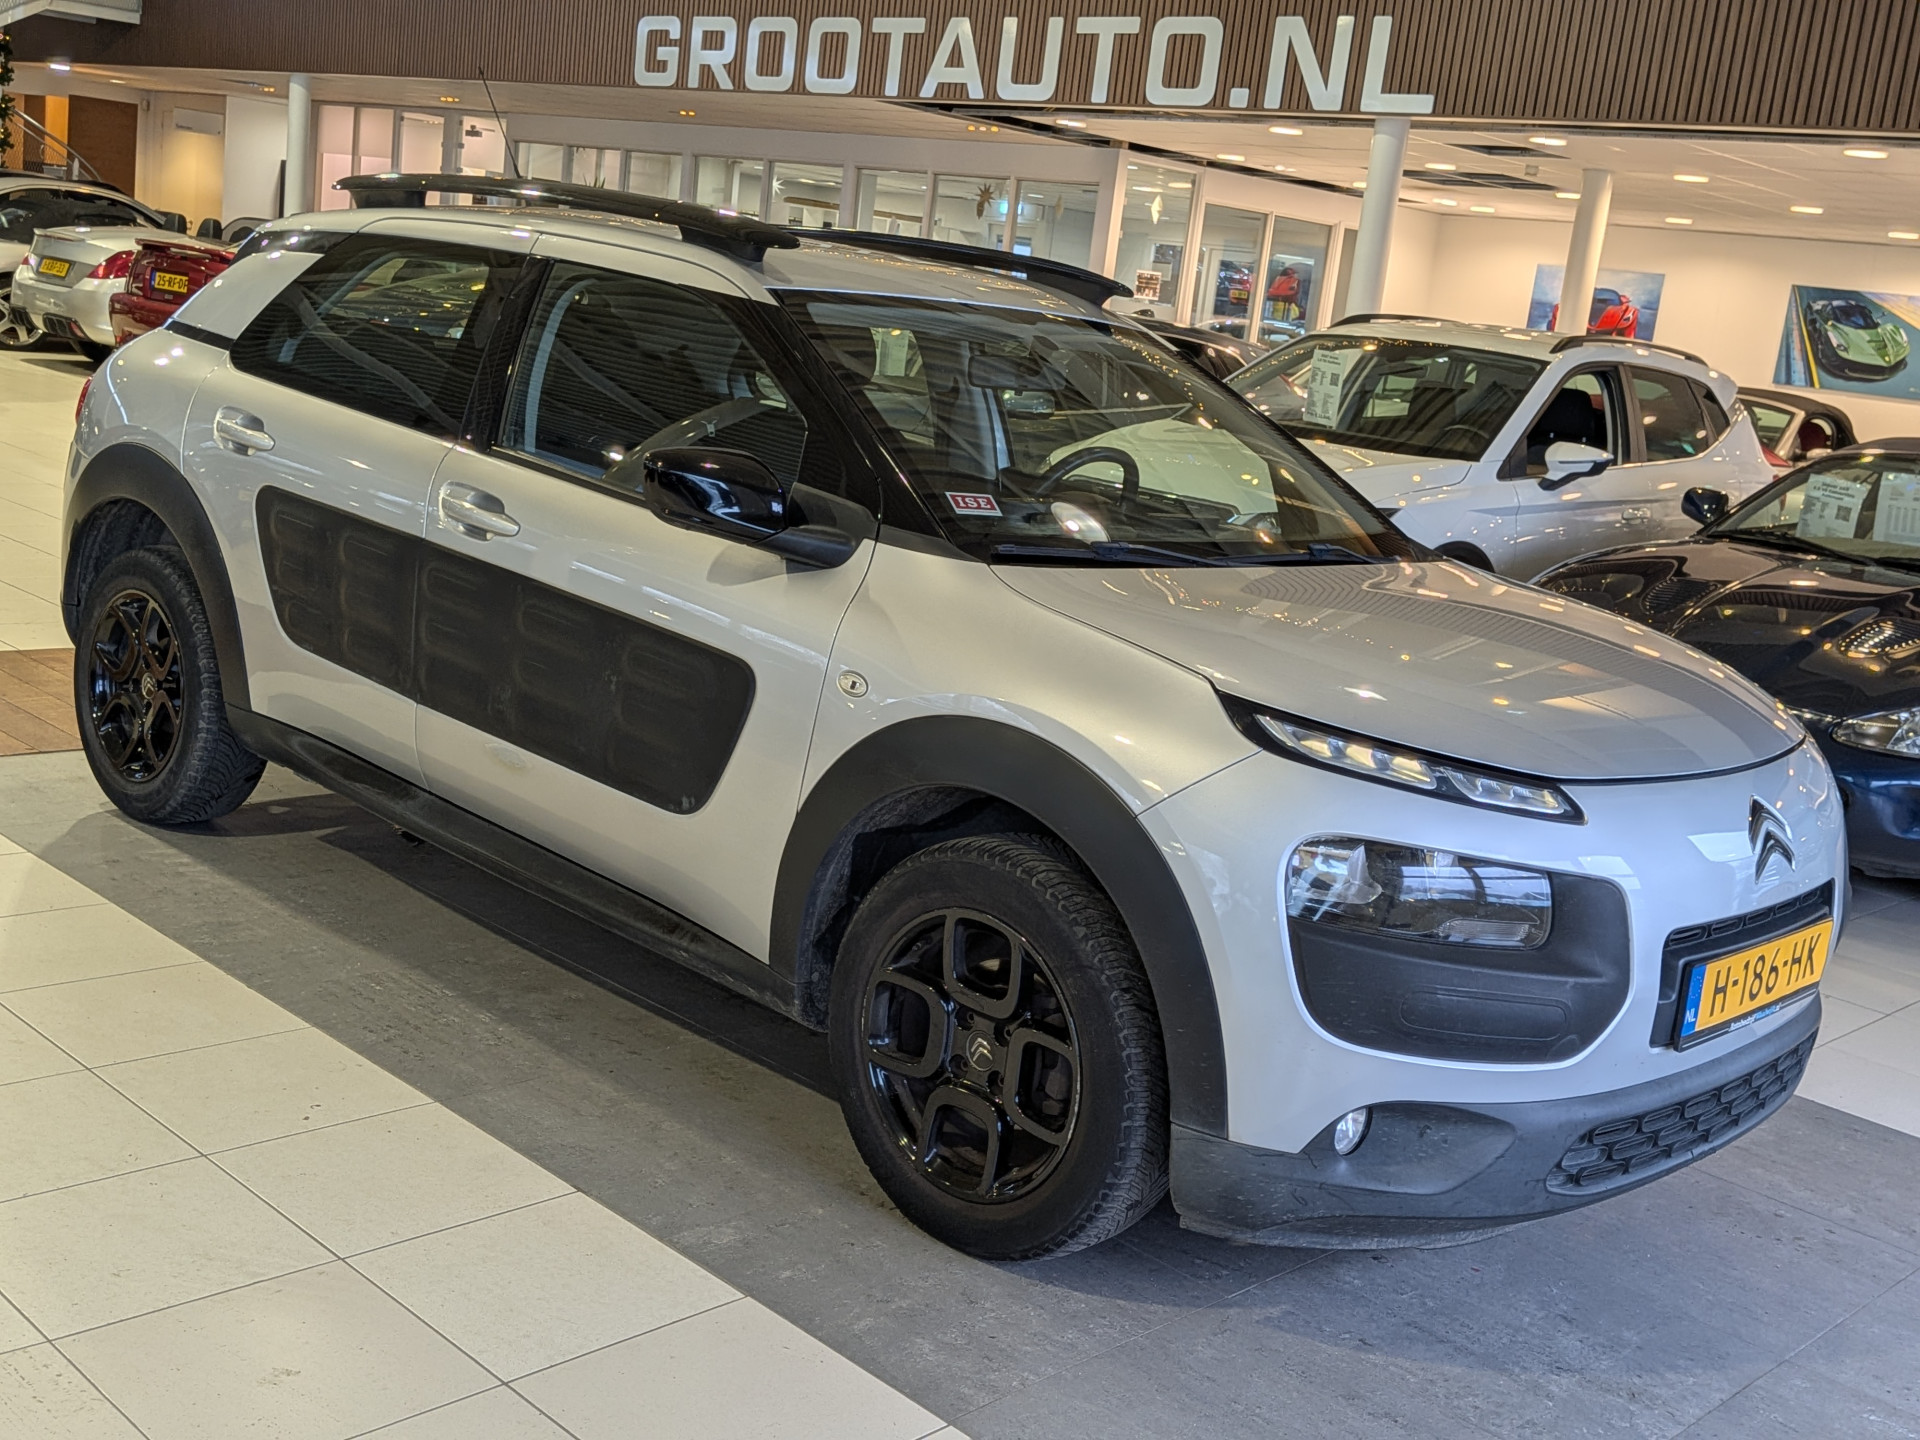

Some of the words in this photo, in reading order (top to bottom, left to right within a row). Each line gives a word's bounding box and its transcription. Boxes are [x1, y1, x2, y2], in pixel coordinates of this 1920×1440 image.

[634, 14, 1435, 114] GROOTAUTO.NL
[955, 497, 991, 508] ISE
[1710, 932, 1821, 1017] H-186-HK
[1684, 1010, 1696, 1024] NL
